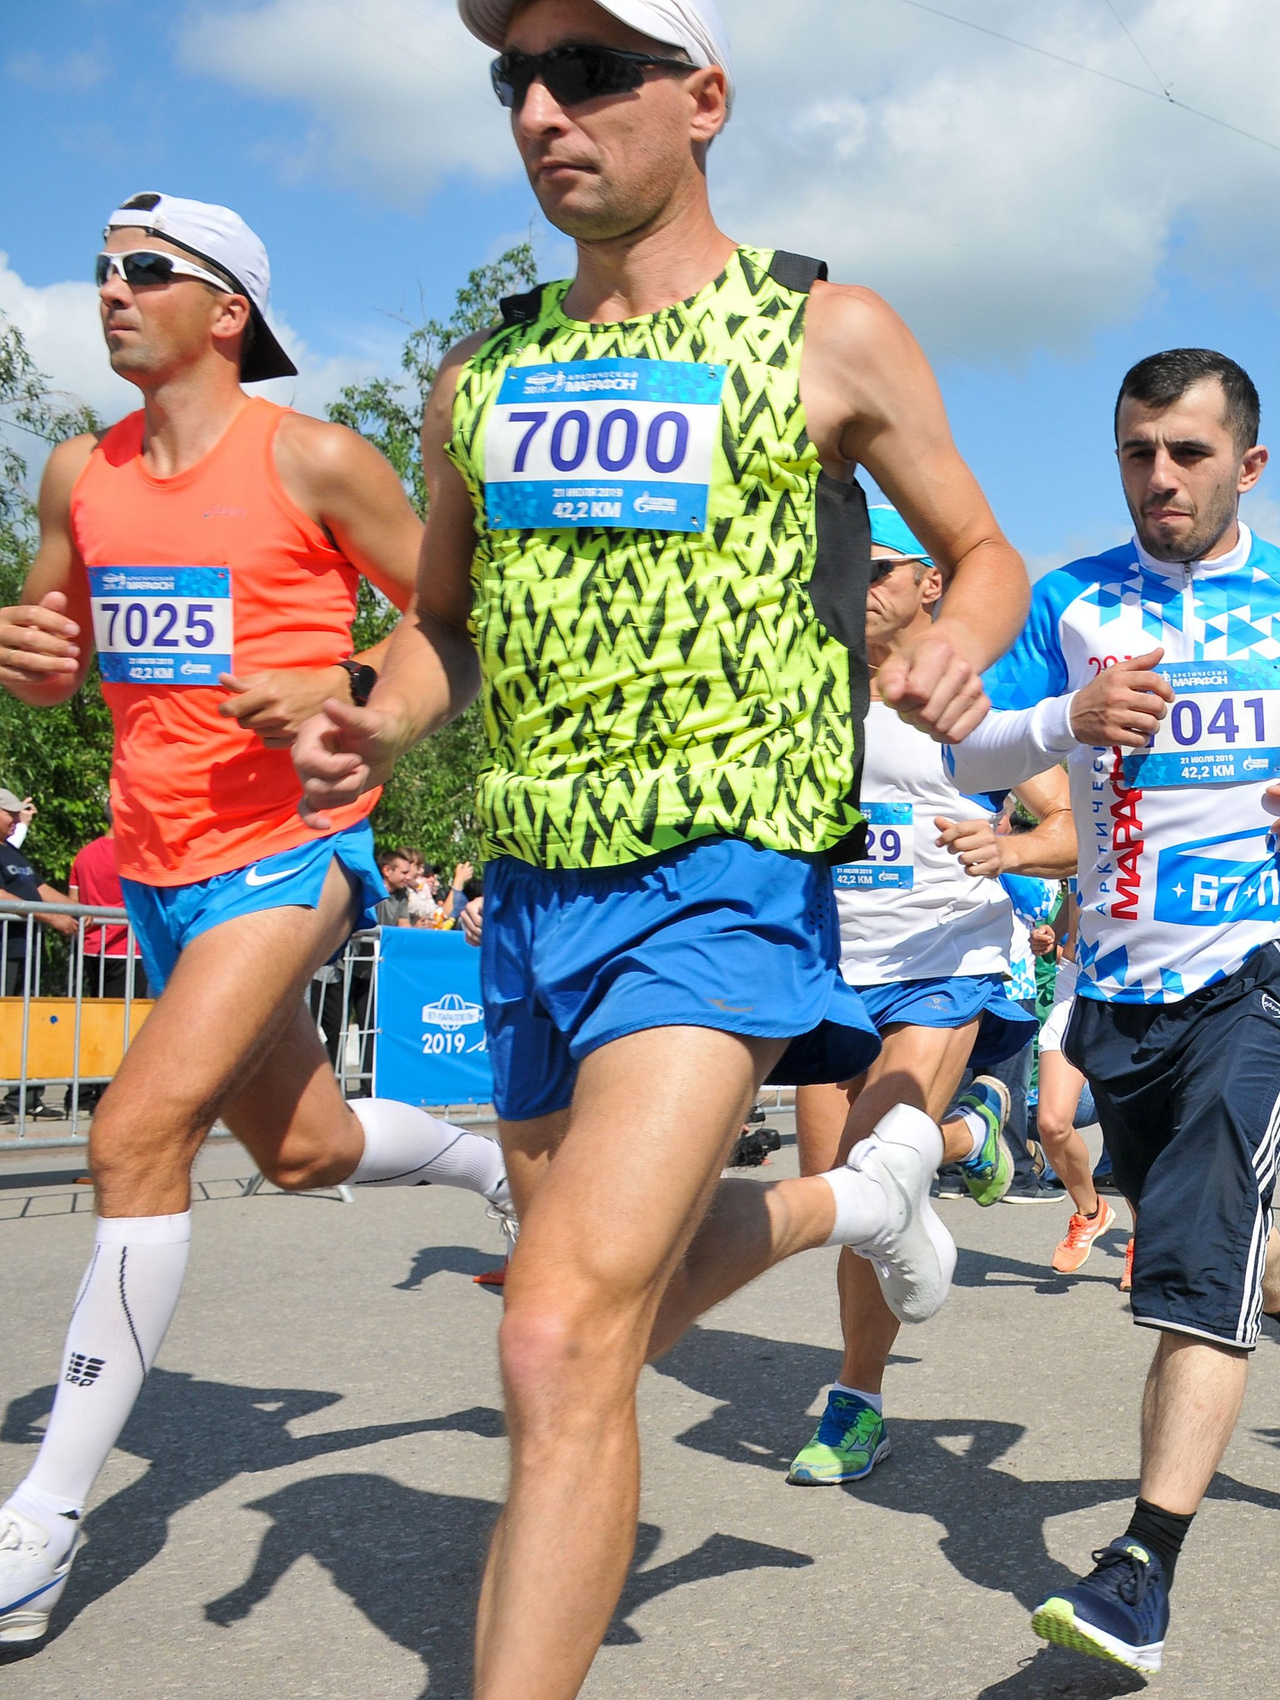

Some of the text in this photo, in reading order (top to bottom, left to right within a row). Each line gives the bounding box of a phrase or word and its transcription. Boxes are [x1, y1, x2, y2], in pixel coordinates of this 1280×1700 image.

[509, 409, 689, 473] 7000
[552, 502, 588, 521] 42,2
[102, 603, 214, 648] 7025
[1172, 675, 1228, 687] МАРАФОН
[1147, 697, 1265, 748] 041
[1181, 765, 1235, 779] 42,2 КМ
[1091, 746, 1113, 917] АРКТИЧЕС
[837, 875, 856, 885] 42,2
[421, 1033, 466, 1054] 2019
